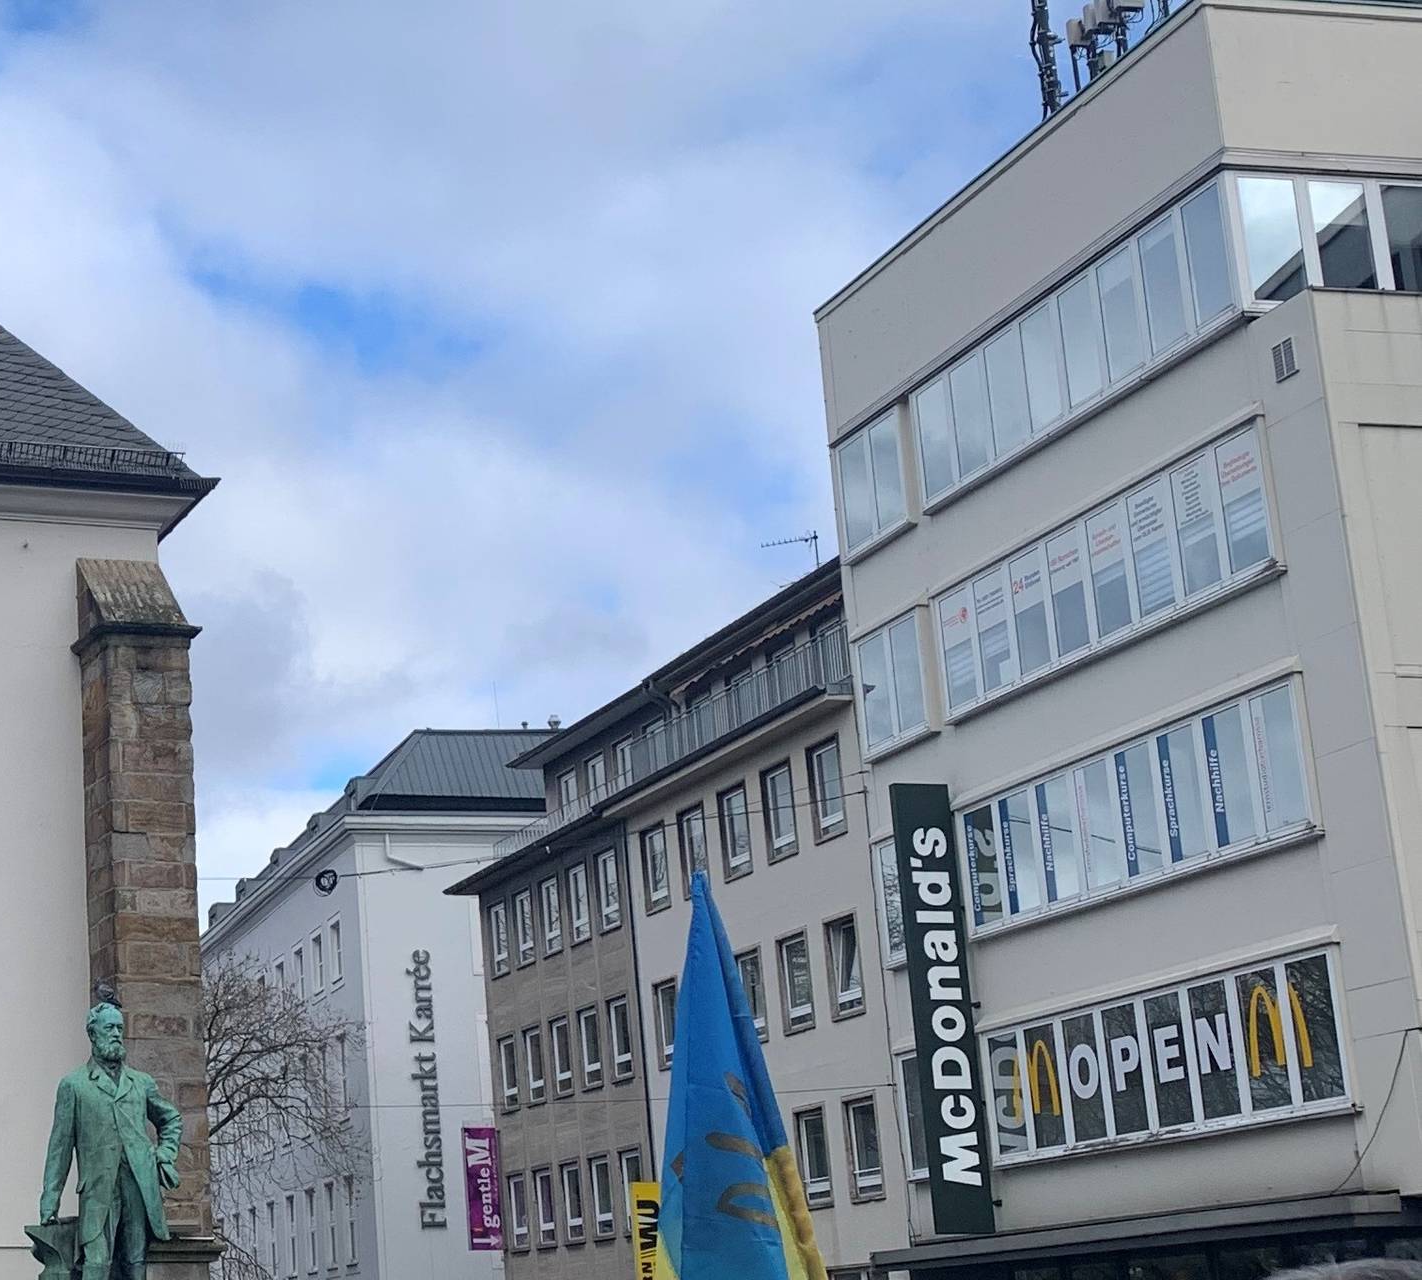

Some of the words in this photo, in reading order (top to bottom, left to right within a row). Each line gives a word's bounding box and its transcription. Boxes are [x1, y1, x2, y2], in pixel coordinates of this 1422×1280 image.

[1118, 765, 1135, 861] Computerkurse
[1162, 760, 1178, 837] Sprachkurse
[1208, 749, 1225, 813] Nachhilfe
[967, 825, 981, 911] Computerkurse
[1002, 821, 1017, 892] Sprachkurse
[1040, 814, 1054, 871] Nachhilfe
[406, 949, 436, 1043] Karrée
[910, 826, 982, 1187] McDonald's
[1069, 1013, 1232, 1099] OPEN
[411, 1052, 447, 1230] Flachsmarkt
[636, 1199, 659, 1251] WU
